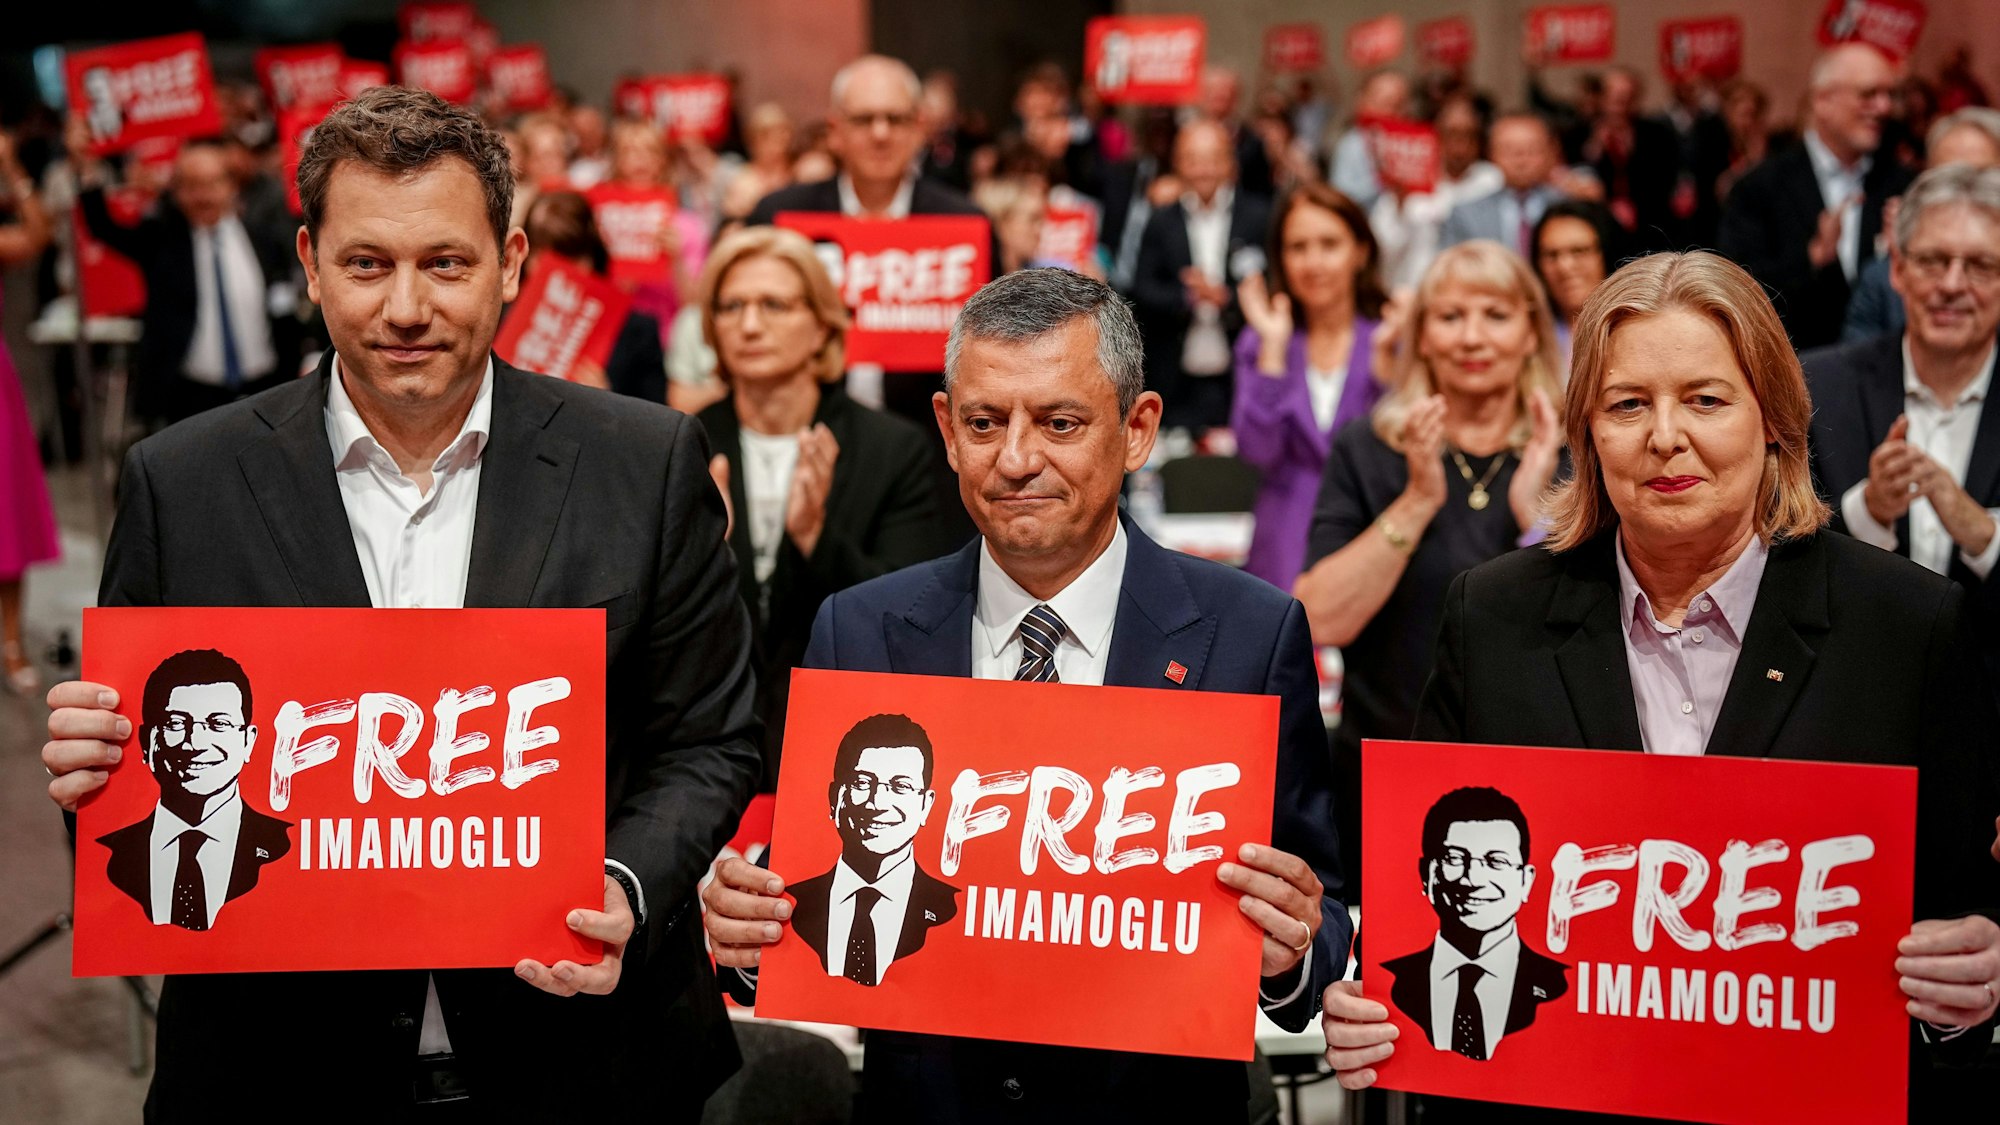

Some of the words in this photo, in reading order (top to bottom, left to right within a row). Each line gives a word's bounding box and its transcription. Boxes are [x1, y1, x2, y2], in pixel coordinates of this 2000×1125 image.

[845, 244, 976, 308] FREE
[269, 676, 572, 812] FREE
[300, 816, 541, 870] IMAMOGLU
[940, 762, 1241, 877] FREE
[964, 885, 1201, 955] IMAMOGLU
[1546, 834, 1875, 954] FREE
[1577, 961, 1836, 1033] IMAMOGLU
